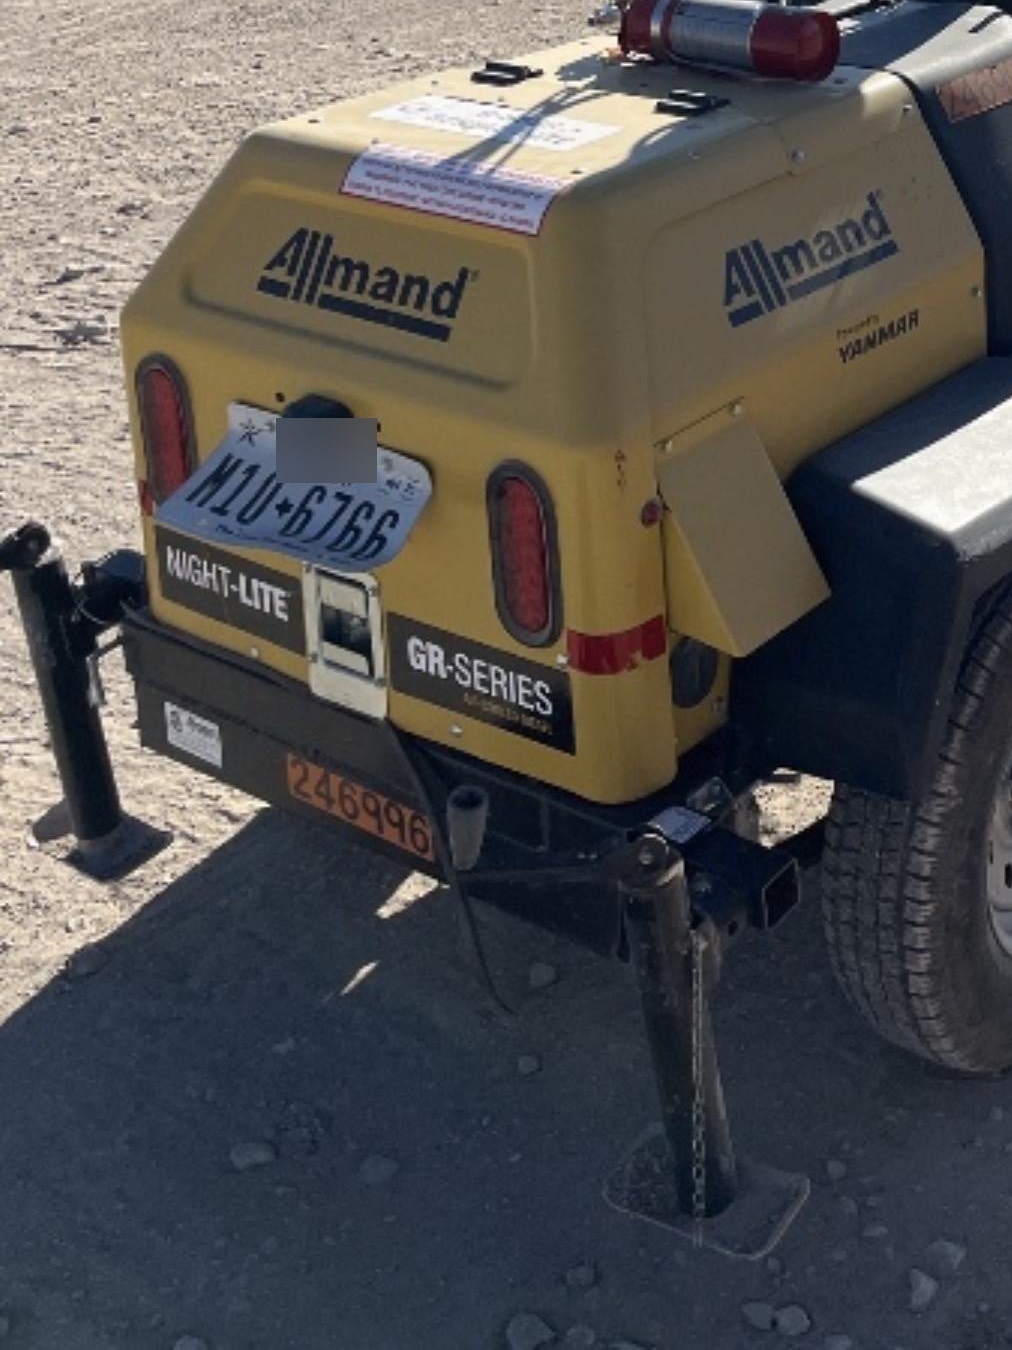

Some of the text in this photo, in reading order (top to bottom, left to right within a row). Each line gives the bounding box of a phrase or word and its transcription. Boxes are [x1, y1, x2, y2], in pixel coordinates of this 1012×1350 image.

[264, 228, 468, 318] Allmand
[724, 189, 891, 312] Allmand
[838, 309, 919, 363] YANMAR
[167, 546, 288, 622] NIGHT-LITE
[407, 636, 552, 715] GR-SERIES
[290, 760, 430, 854] 246996
